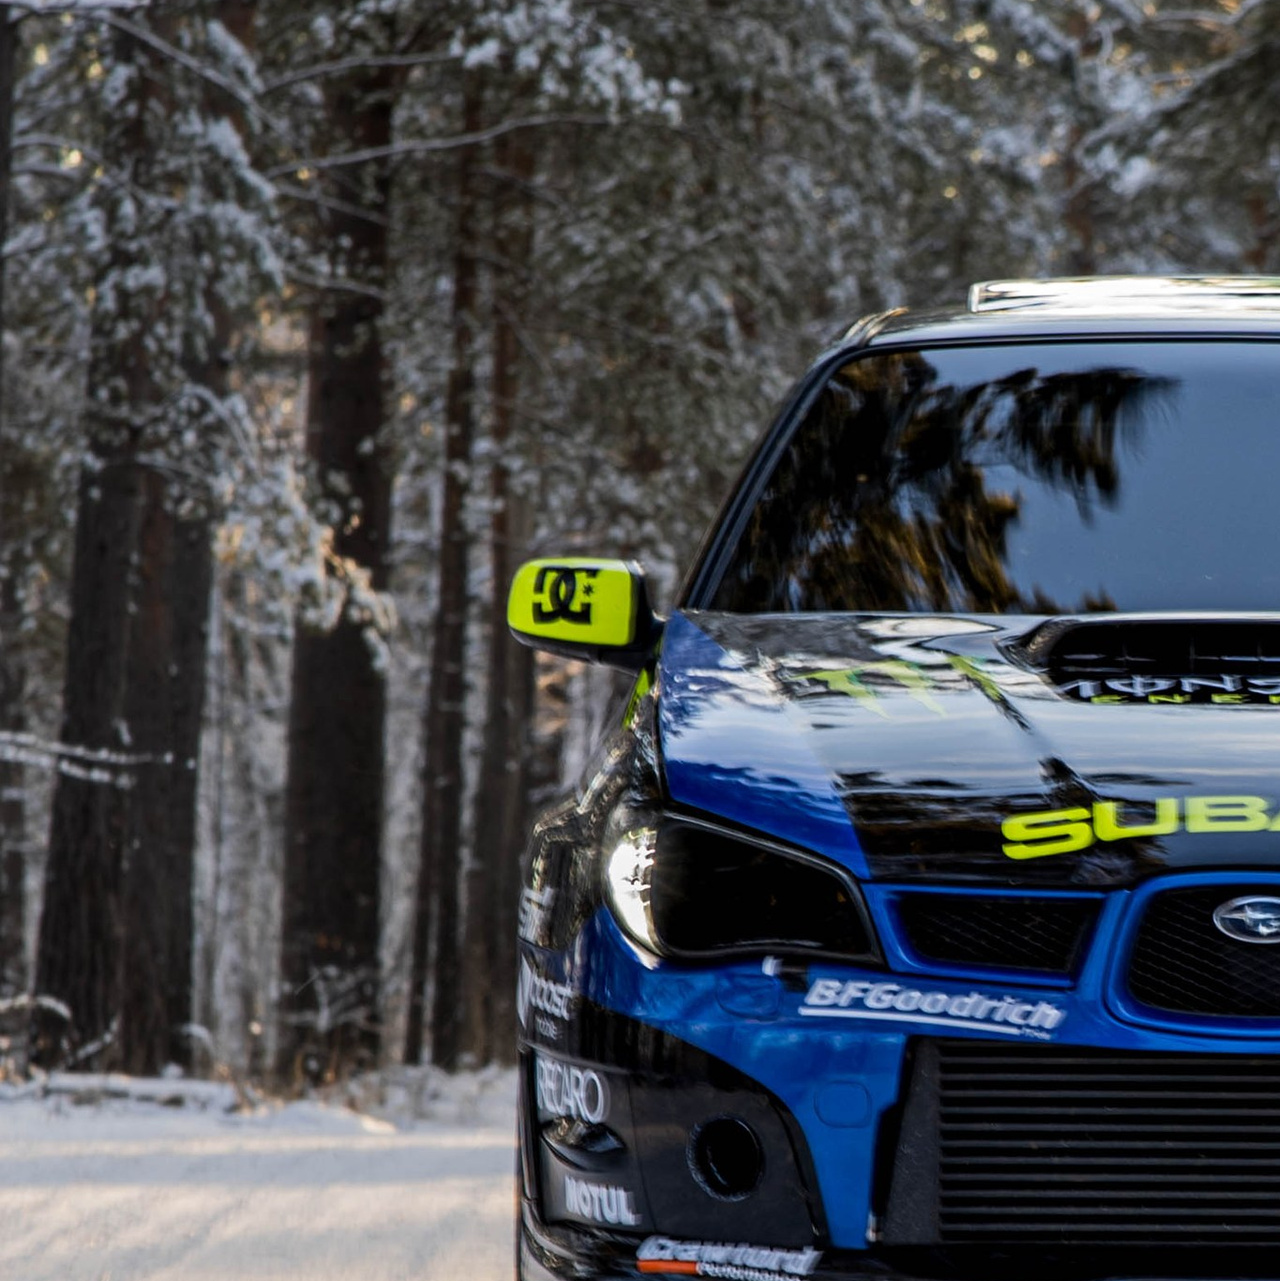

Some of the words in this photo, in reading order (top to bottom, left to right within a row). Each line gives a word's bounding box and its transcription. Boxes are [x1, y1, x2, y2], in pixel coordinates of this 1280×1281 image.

[804, 978, 1067, 1029] BFGoodrich
[535, 1056, 611, 1124] RECARO
[564, 1174, 641, 1226] MOTUL
